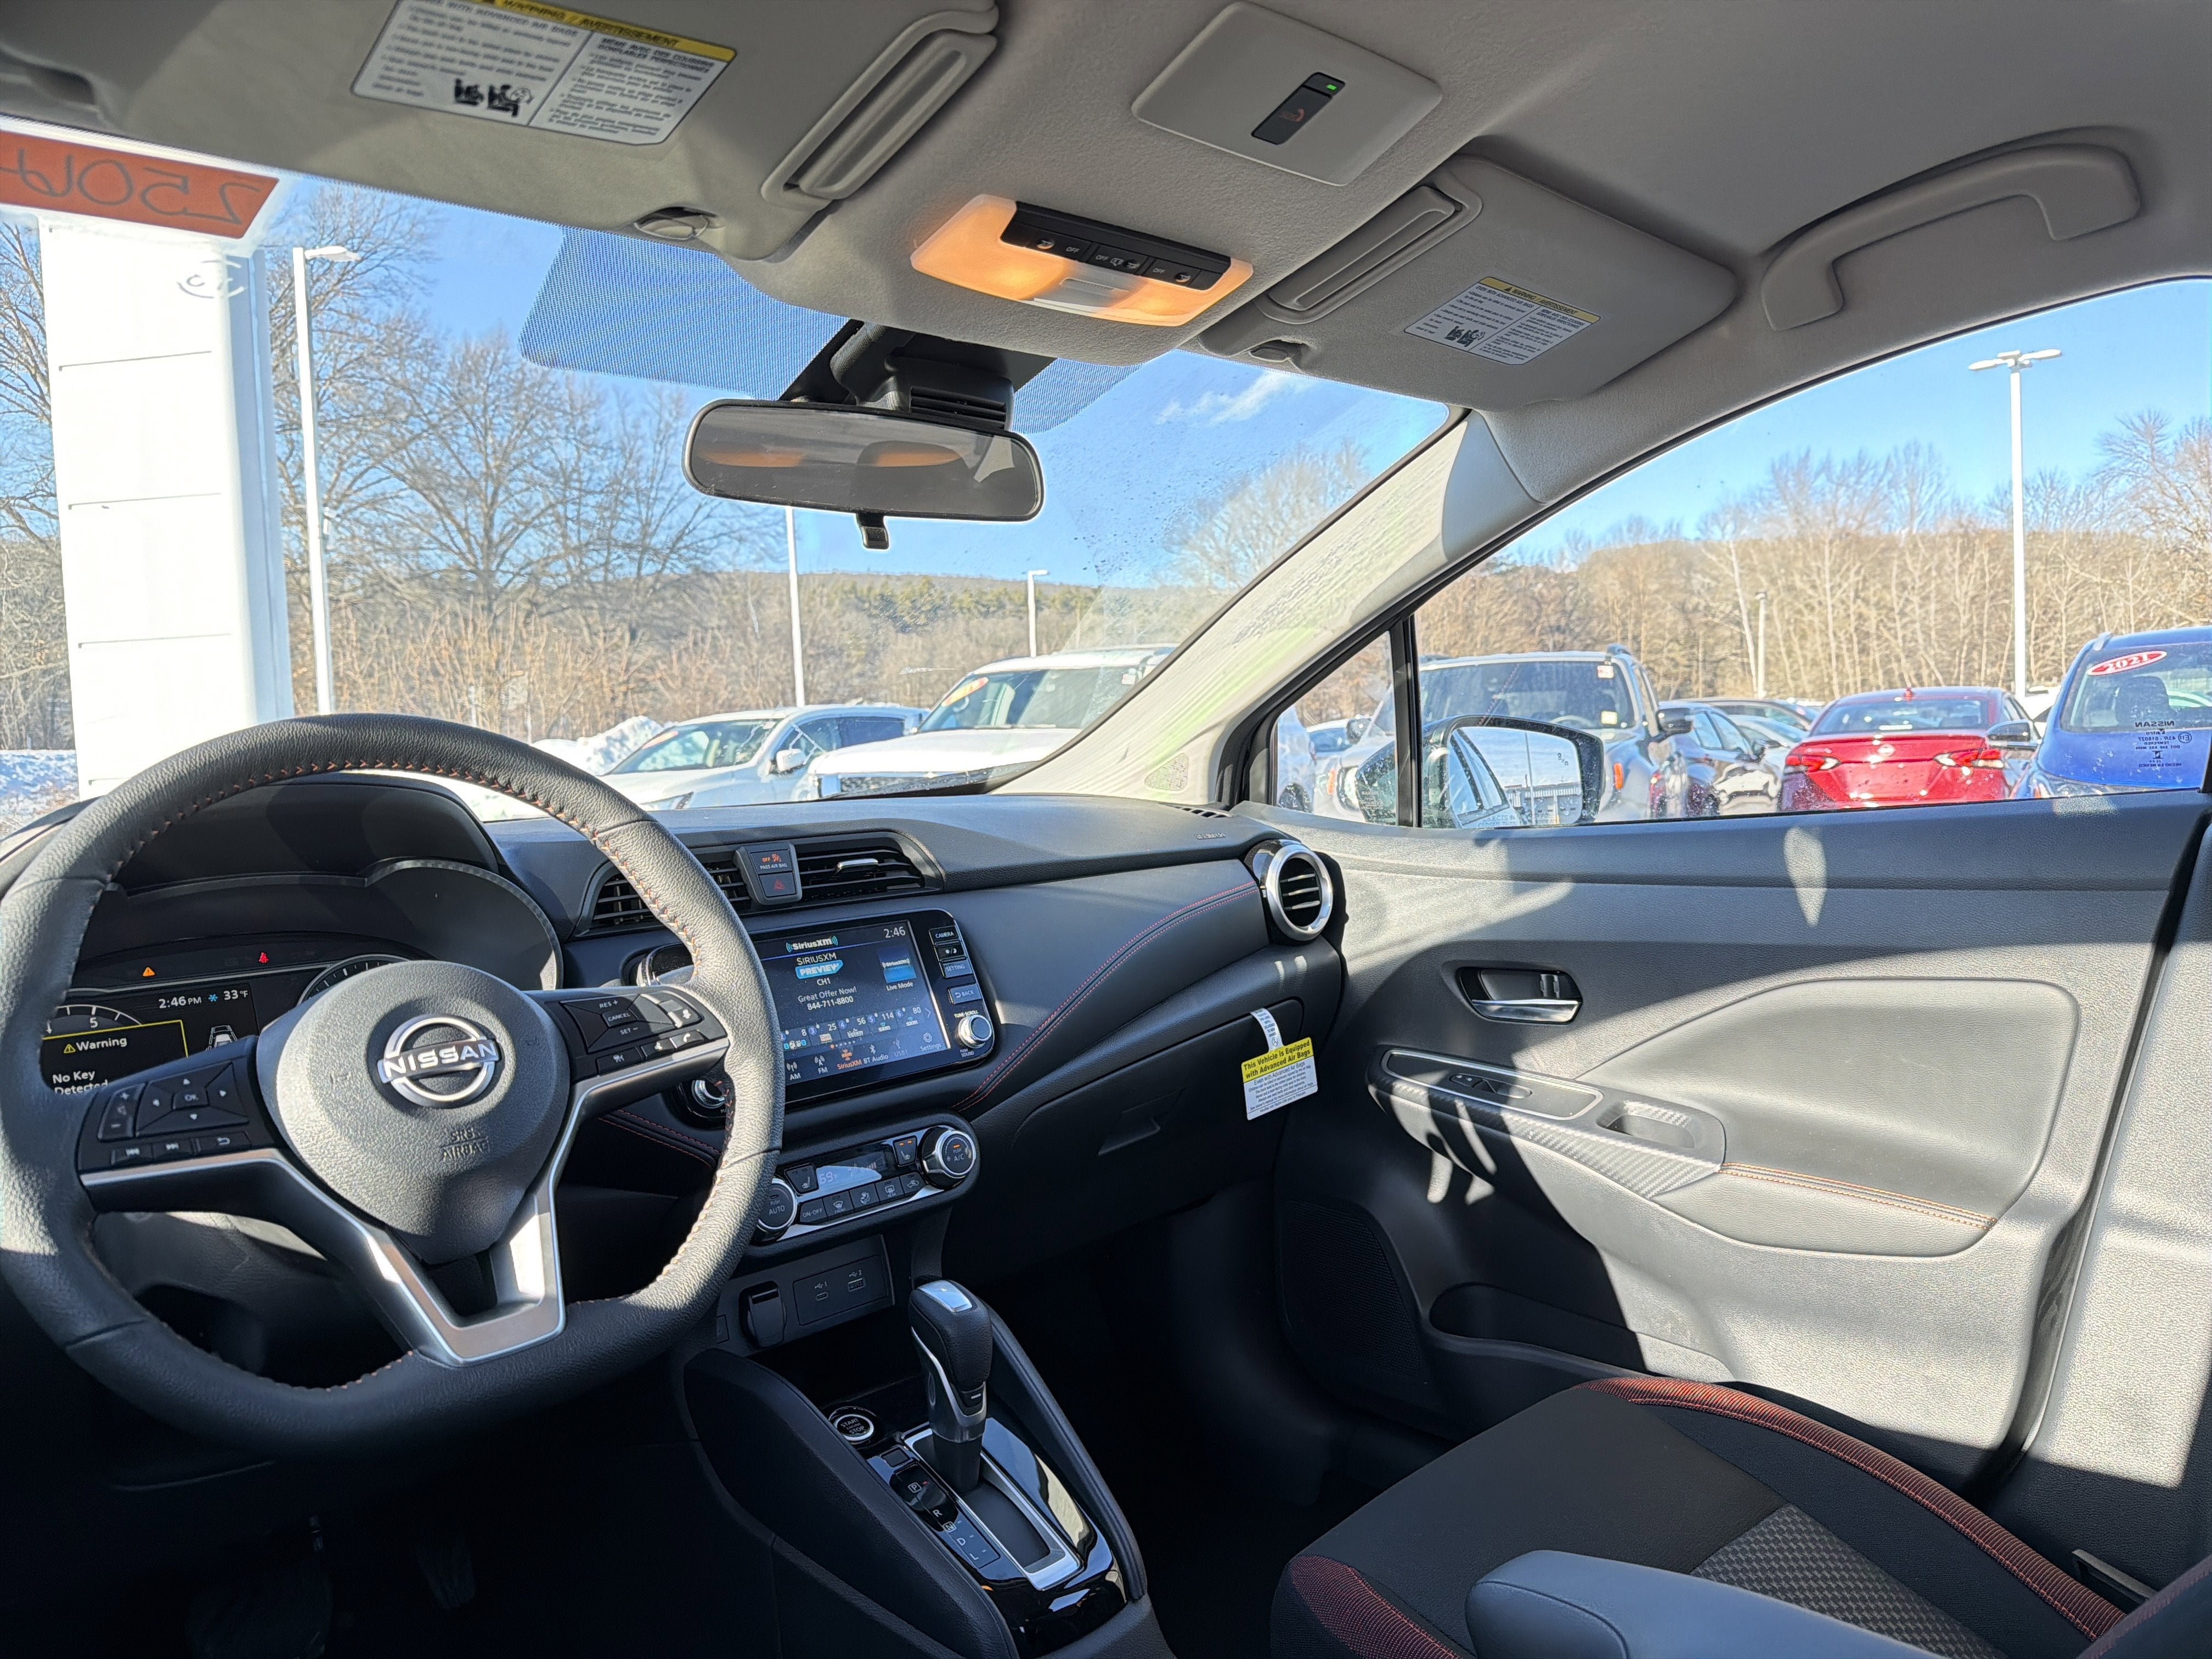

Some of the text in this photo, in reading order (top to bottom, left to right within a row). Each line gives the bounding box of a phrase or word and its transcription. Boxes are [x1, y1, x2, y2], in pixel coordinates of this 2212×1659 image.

[1066, 246, 1080, 255] OFF
[2107, 653, 2148, 670] 2021
[884, 926, 906, 938] 2:46
[796, 952, 837, 966] SIRIUSXM
[799, 963, 839, 976] PREVIEW
[946, 964, 966, 972] SETTING
[816, 977, 831, 986] CH1
[798, 986, 857, 1003] Great Offer Now!
[159, 996, 202, 1009] 2:46 PM
[807, 996, 854, 1011] 844-711-8800
[607, 1012, 631, 1022] CANCEL
[882, 1012, 895, 1020] 114
[89, 1017, 98, 1029] 5
[856, 1017, 866, 1026] 56
[619, 1027, 631, 1035] SET
[827, 1023, 837, 1031] 25
[76, 1037, 128, 1052] Warning
[919, 1043, 943, 1052] Settings
[872, 1054, 889, 1063] Audio
[1244, 1062, 1256, 1070] This
[1257, 1053, 1278, 1065] Vehicle
[1285, 1040, 1310, 1054] Equipped
[383, 1043, 498, 1079] NISSAN
[837, 1060, 862, 1070] SiriusXM
[1245, 1070, 1258, 1079] with
[1260, 1058, 1286, 1074] Advanced
[1297, 1049, 1310, 1058] Bags
[52, 1071, 96, 1085] No Key
[1254, 1076, 1263, 1086] Even
[184, 1093, 199, 1102] OK
[954, 1153, 964, 1161] A/C
[769, 1205, 786, 1216] AUTO
[840, 1418, 859, 1427] START
[849, 1426, 865, 1435] STOP
[933, 1509, 943, 1518] R
[957, 1537, 966, 1546] D
[969, 1553, 979, 1561] L
